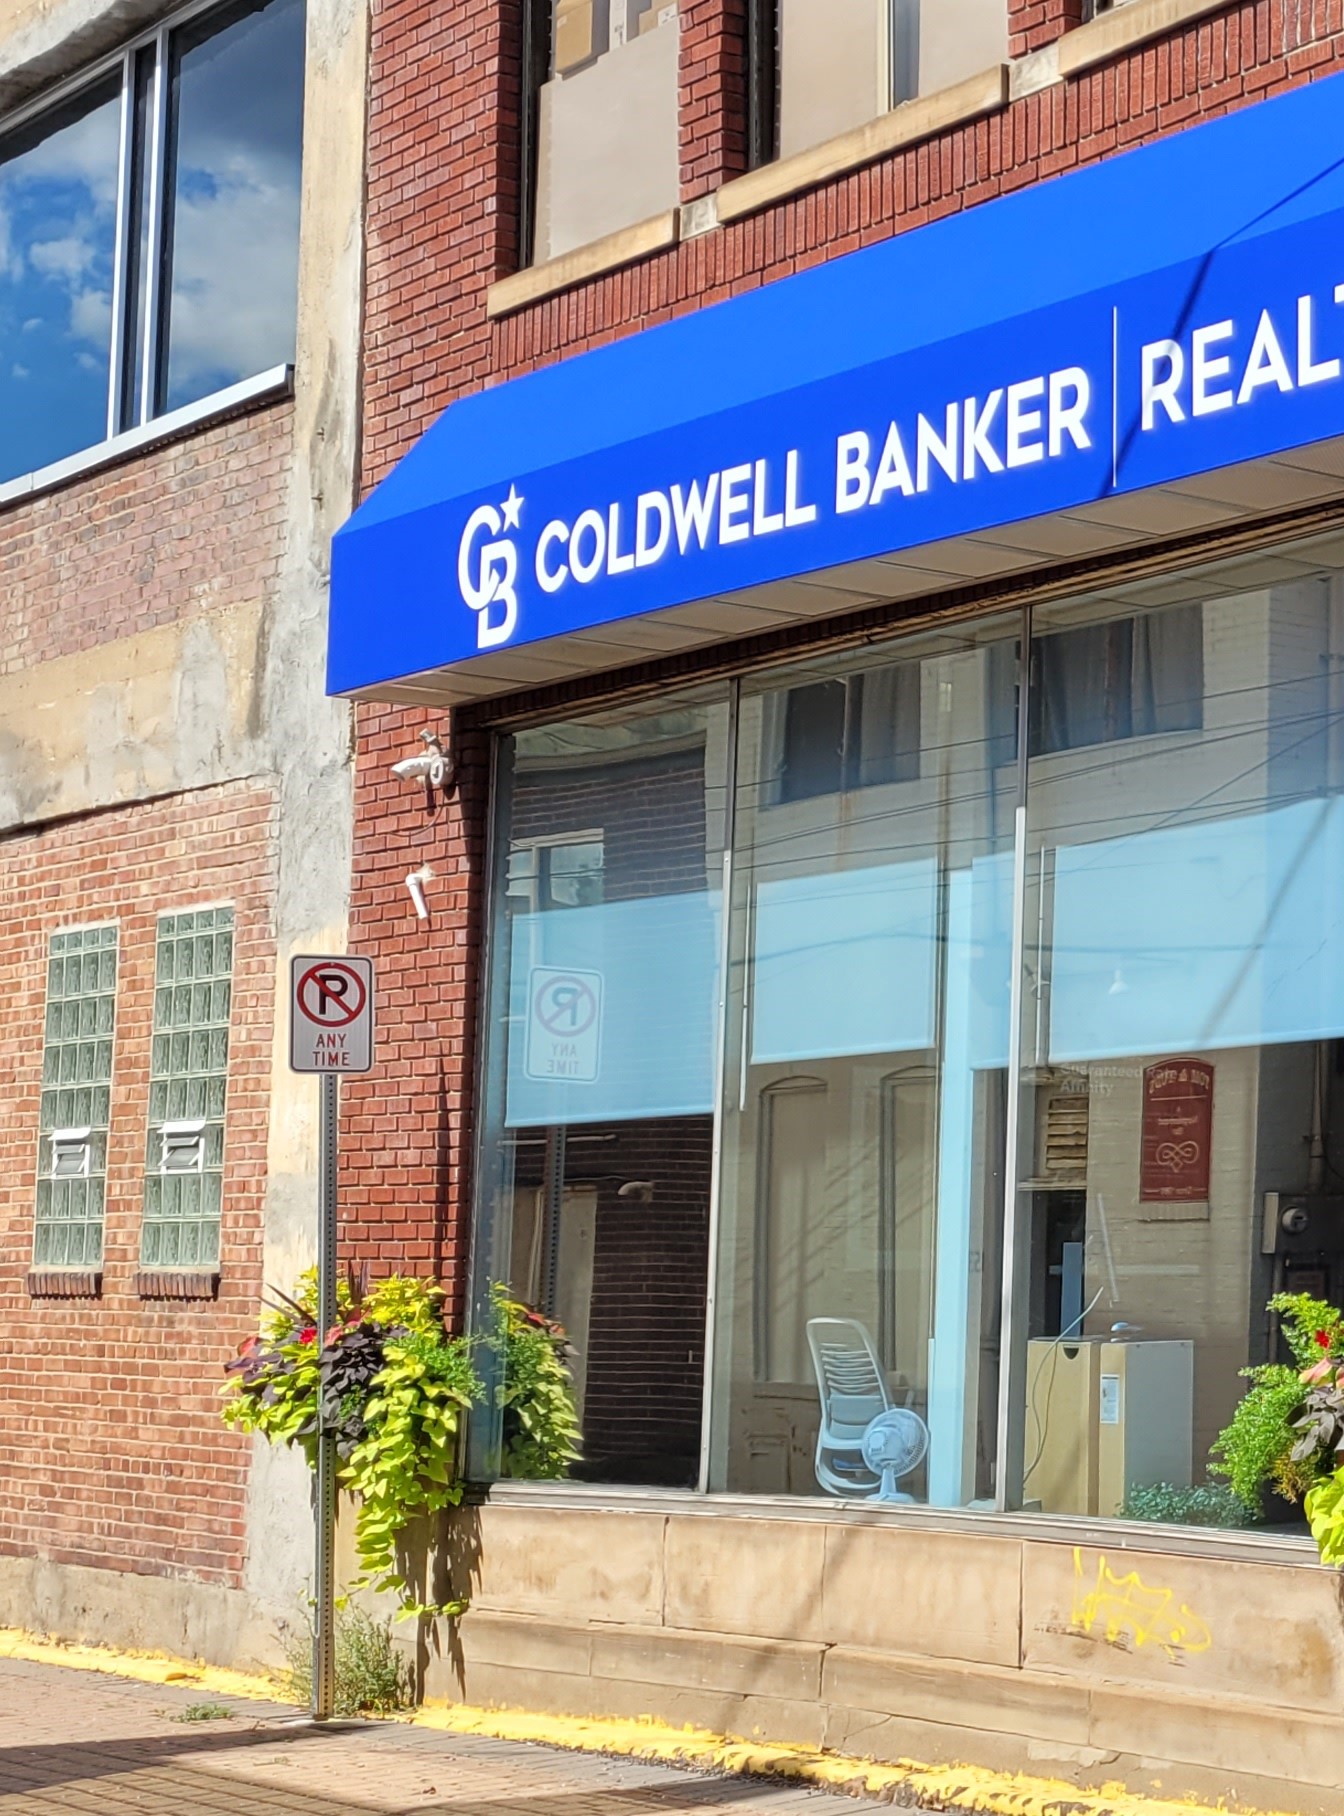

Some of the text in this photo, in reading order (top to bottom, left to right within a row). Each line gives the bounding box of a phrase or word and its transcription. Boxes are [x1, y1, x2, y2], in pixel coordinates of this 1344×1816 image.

[535, 449, 817, 593] COLDWELL
[835, 366, 1092, 514] BANKER
[316, 1033, 347, 1048] ANY
[313, 1051, 351, 1066] TIME
[1061, 1063, 1142, 1078] Guaranteed
[1060, 1077, 1114, 1096] Affinity
